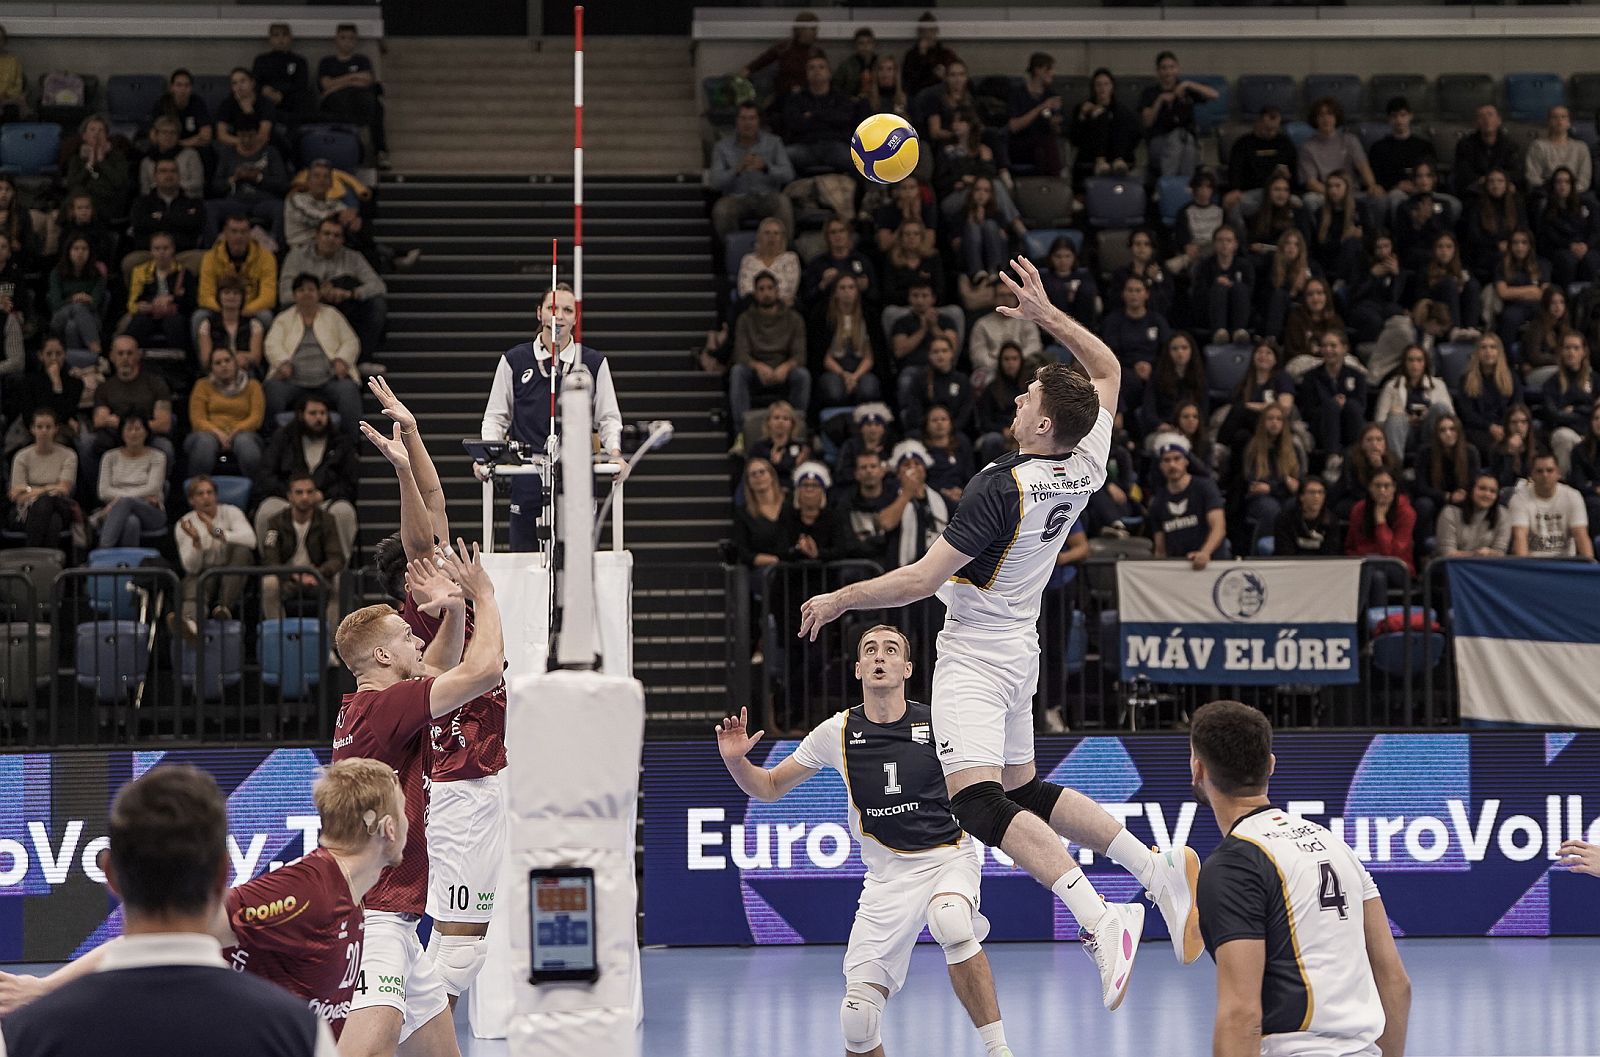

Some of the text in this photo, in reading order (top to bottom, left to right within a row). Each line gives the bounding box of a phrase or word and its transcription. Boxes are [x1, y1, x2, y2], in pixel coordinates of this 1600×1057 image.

[1080, 475, 1091, 488] SC
[1040, 501, 1073, 542] 6
[1126, 627, 1350, 671] MÁV ELŐRE
[939, 747, 954, 756] erima
[883, 762, 902, 795] 1
[448, 884, 470, 911] 10
[1318, 859, 1349, 920] 4
[245, 895, 297, 922] DOMO
[338, 940, 360, 989] 20
[355, 969, 369, 995] 4
